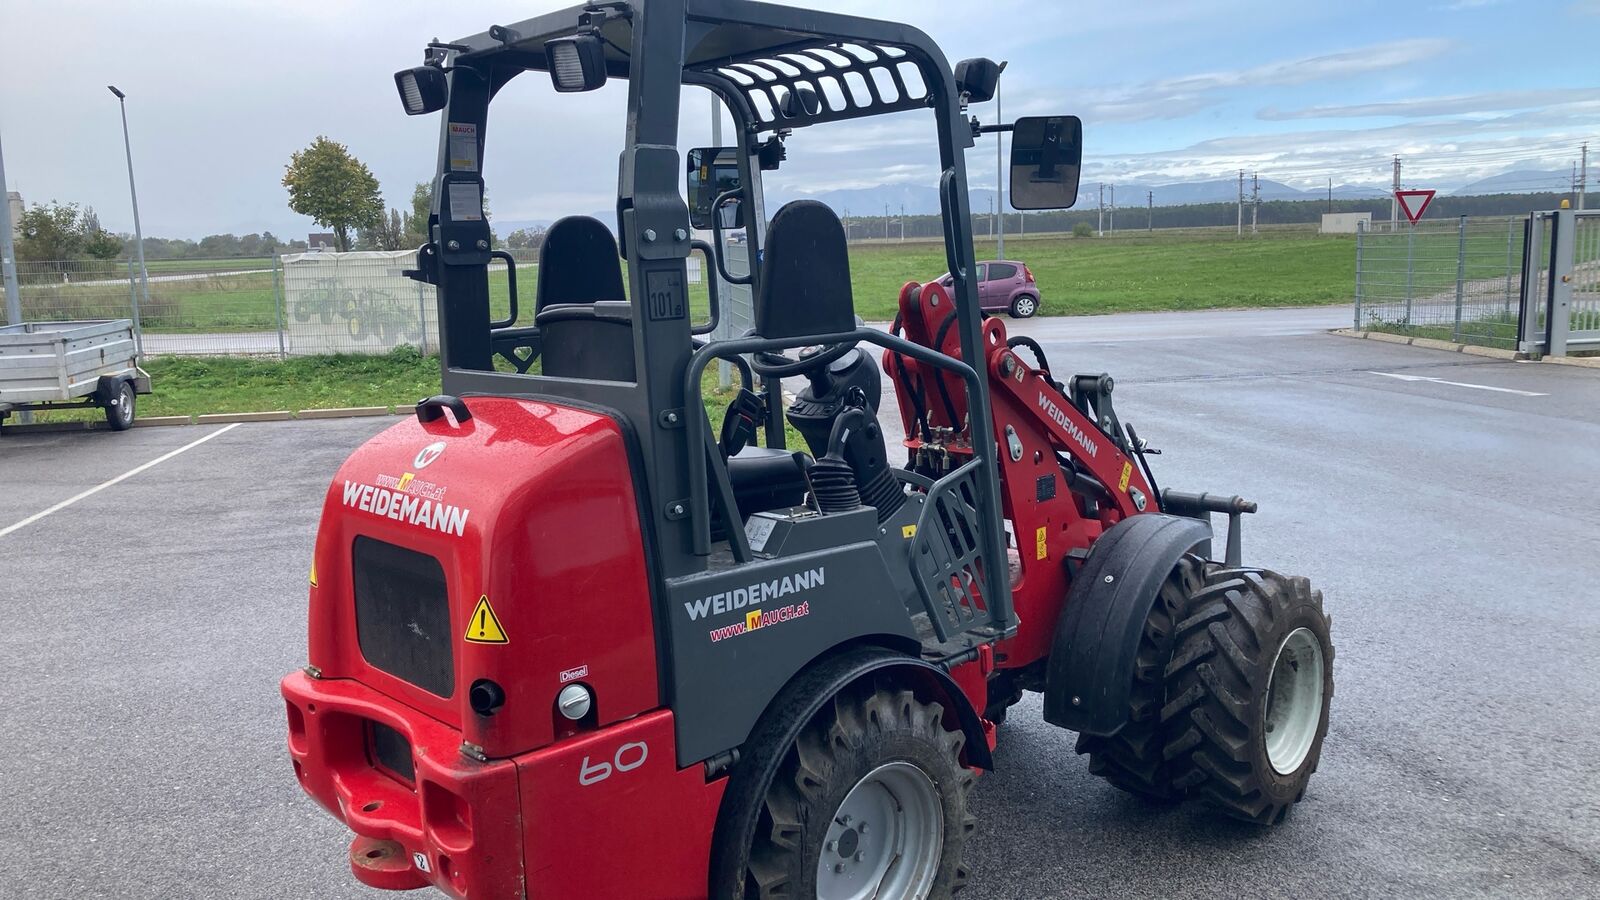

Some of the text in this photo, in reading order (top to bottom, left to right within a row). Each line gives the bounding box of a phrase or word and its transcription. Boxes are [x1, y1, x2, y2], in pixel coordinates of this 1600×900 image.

[651, 292, 672, 316] 101
[1038, 391, 1098, 458] WEIDEMANN
[342, 480, 470, 537] WEIDEMANN
[684, 567, 825, 621] WEIDEMANN
[710, 601, 809, 642] www.MAUCH.at
[562, 667, 586, 681] Diesel
[579, 741, 648, 785] 60
